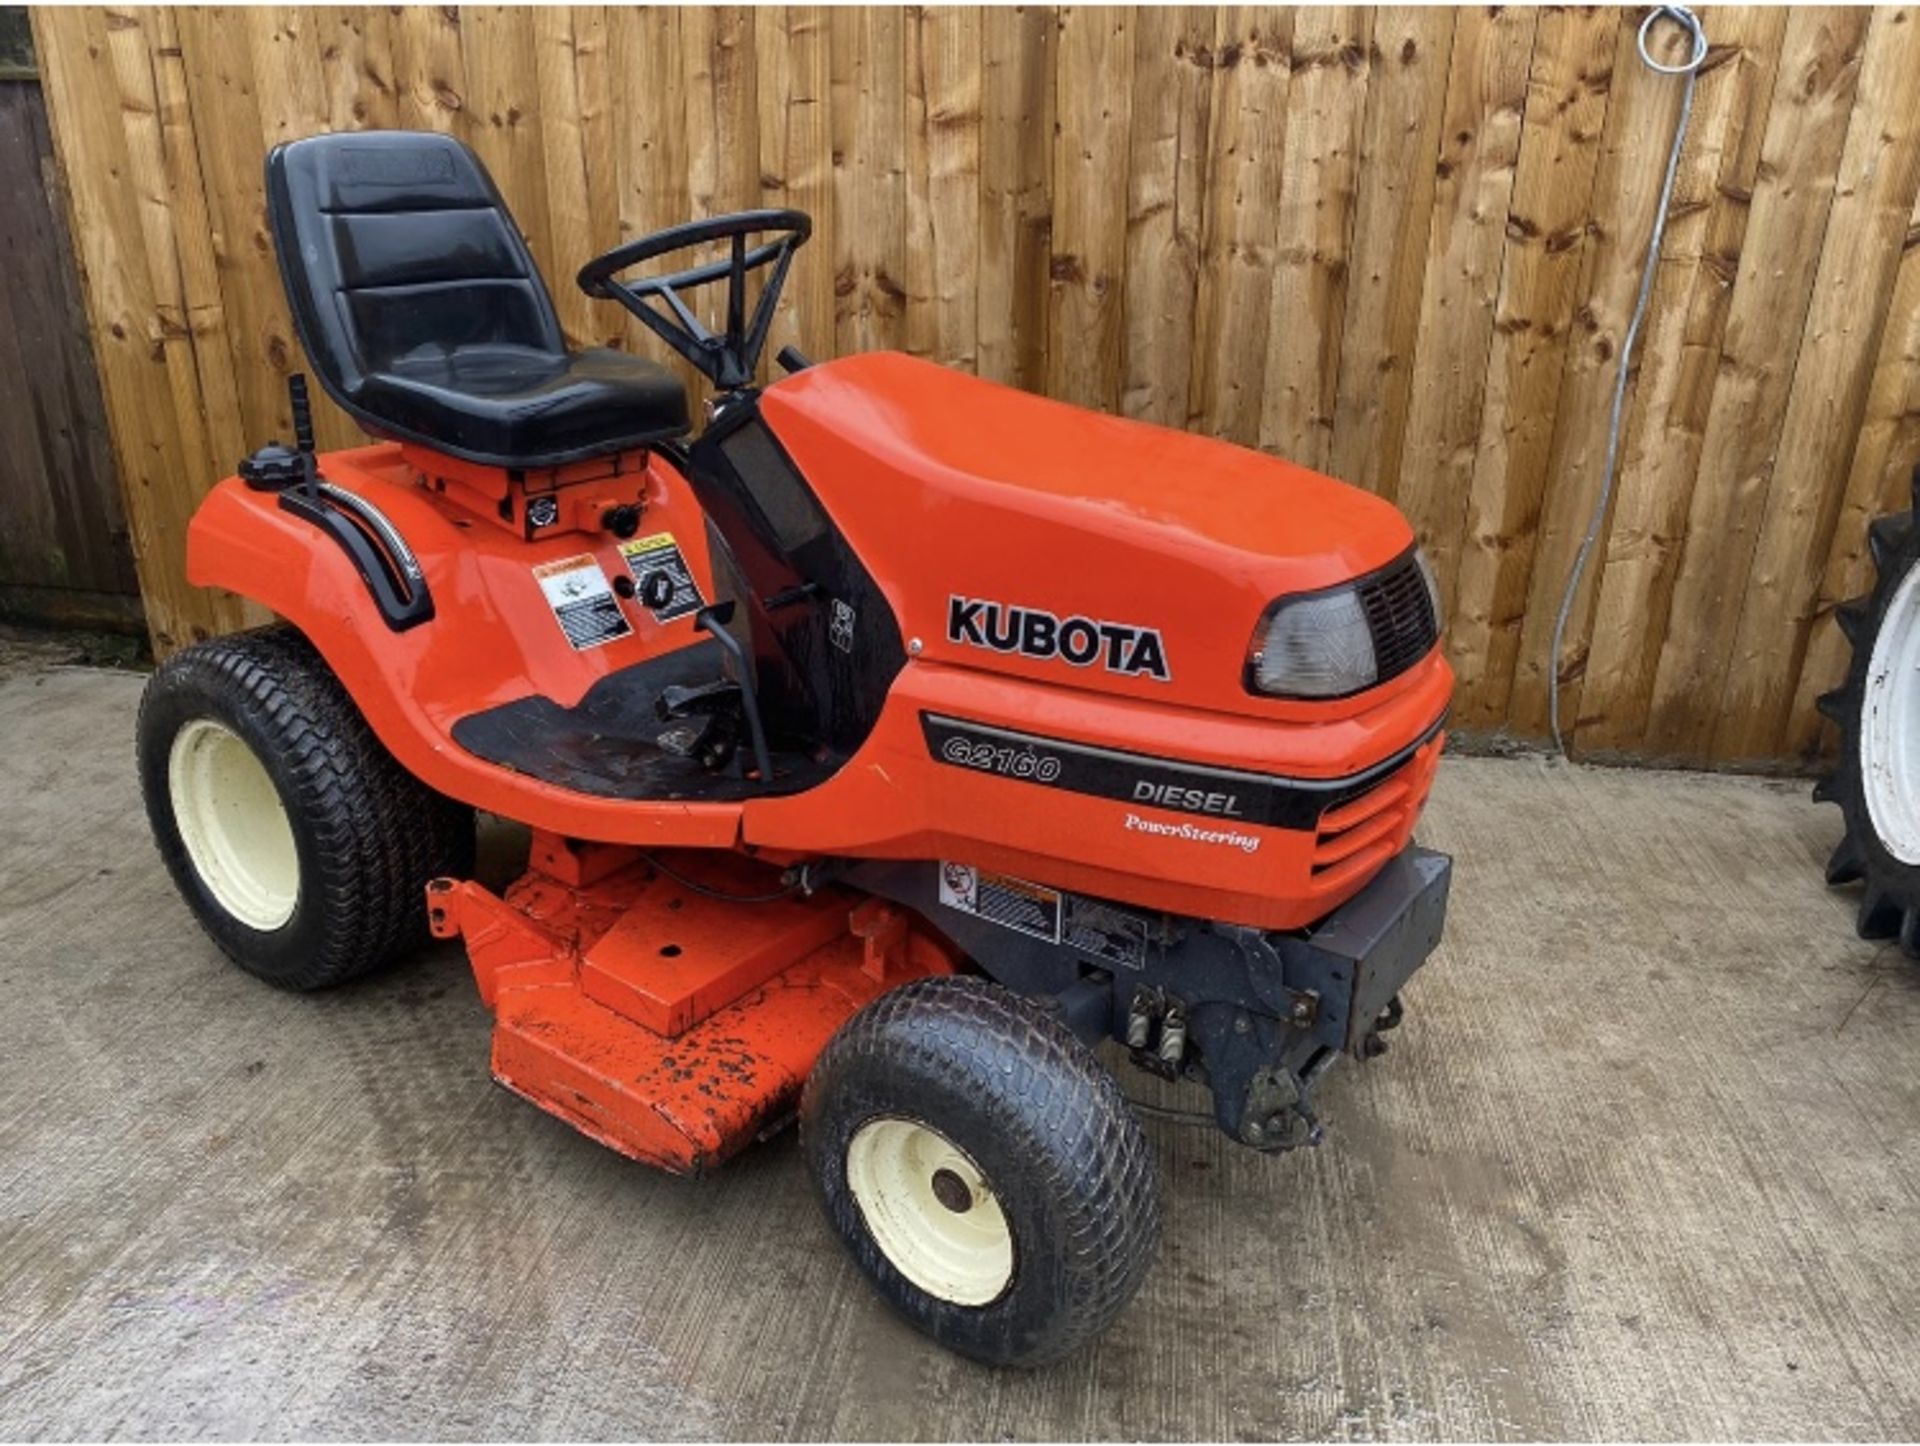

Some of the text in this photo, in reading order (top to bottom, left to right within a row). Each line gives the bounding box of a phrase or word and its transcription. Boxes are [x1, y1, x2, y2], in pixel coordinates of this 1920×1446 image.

[948, 595, 1170, 681] KUBOTA
[943, 737, 1243, 815] G2160 DIESEL
